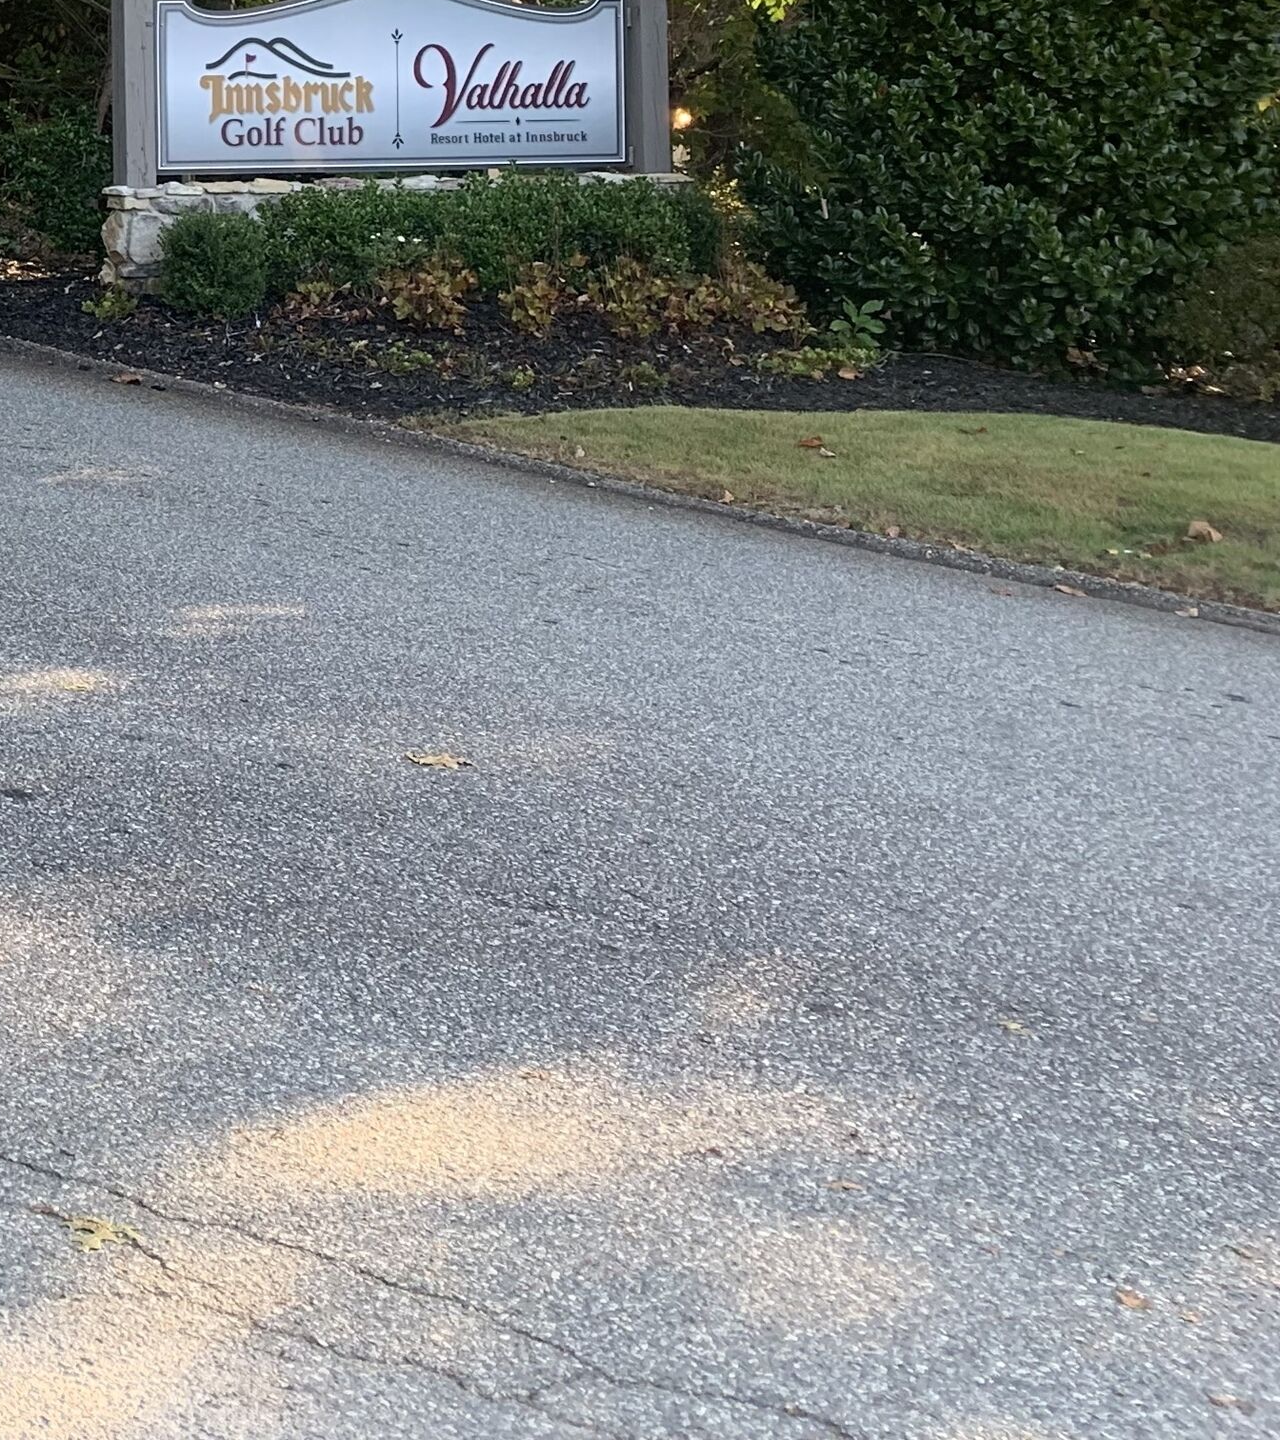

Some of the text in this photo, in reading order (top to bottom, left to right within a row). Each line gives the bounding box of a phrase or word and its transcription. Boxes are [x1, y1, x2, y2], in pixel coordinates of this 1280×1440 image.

[199, 74, 375, 124] Innsbruck
[413, 42, 591, 129] Valhalla
[221, 117, 364, 146] Golf Club
[430, 130, 588, 144] Resort Hotel at Innsbruck
